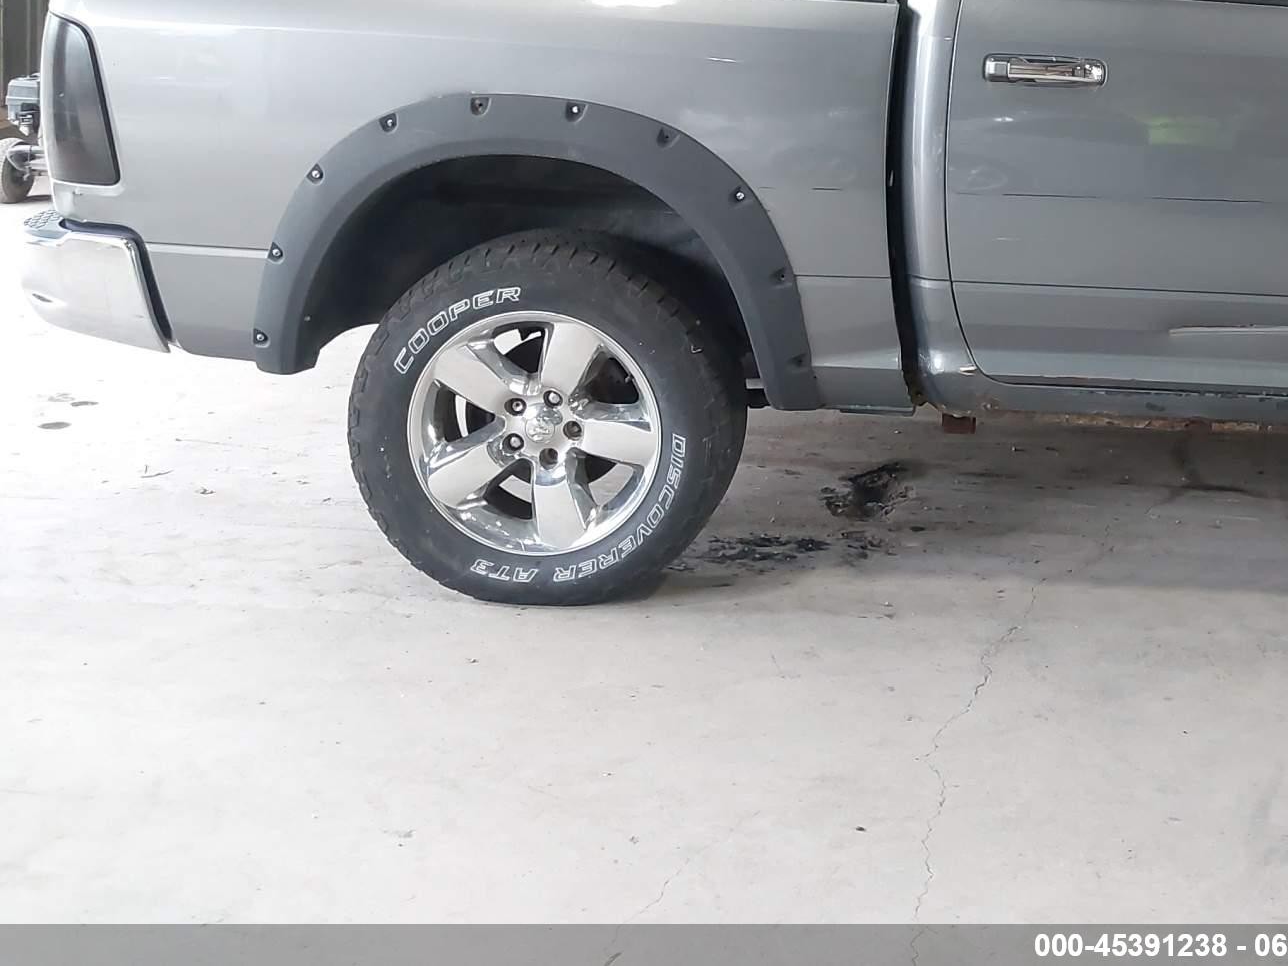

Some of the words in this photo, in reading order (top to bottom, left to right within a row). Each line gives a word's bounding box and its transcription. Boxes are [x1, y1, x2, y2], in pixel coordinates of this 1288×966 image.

[393, 286, 522, 375] COOPER
[552, 433, 687, 583] DISCOVERER
[470, 558, 539, 583] AT3
